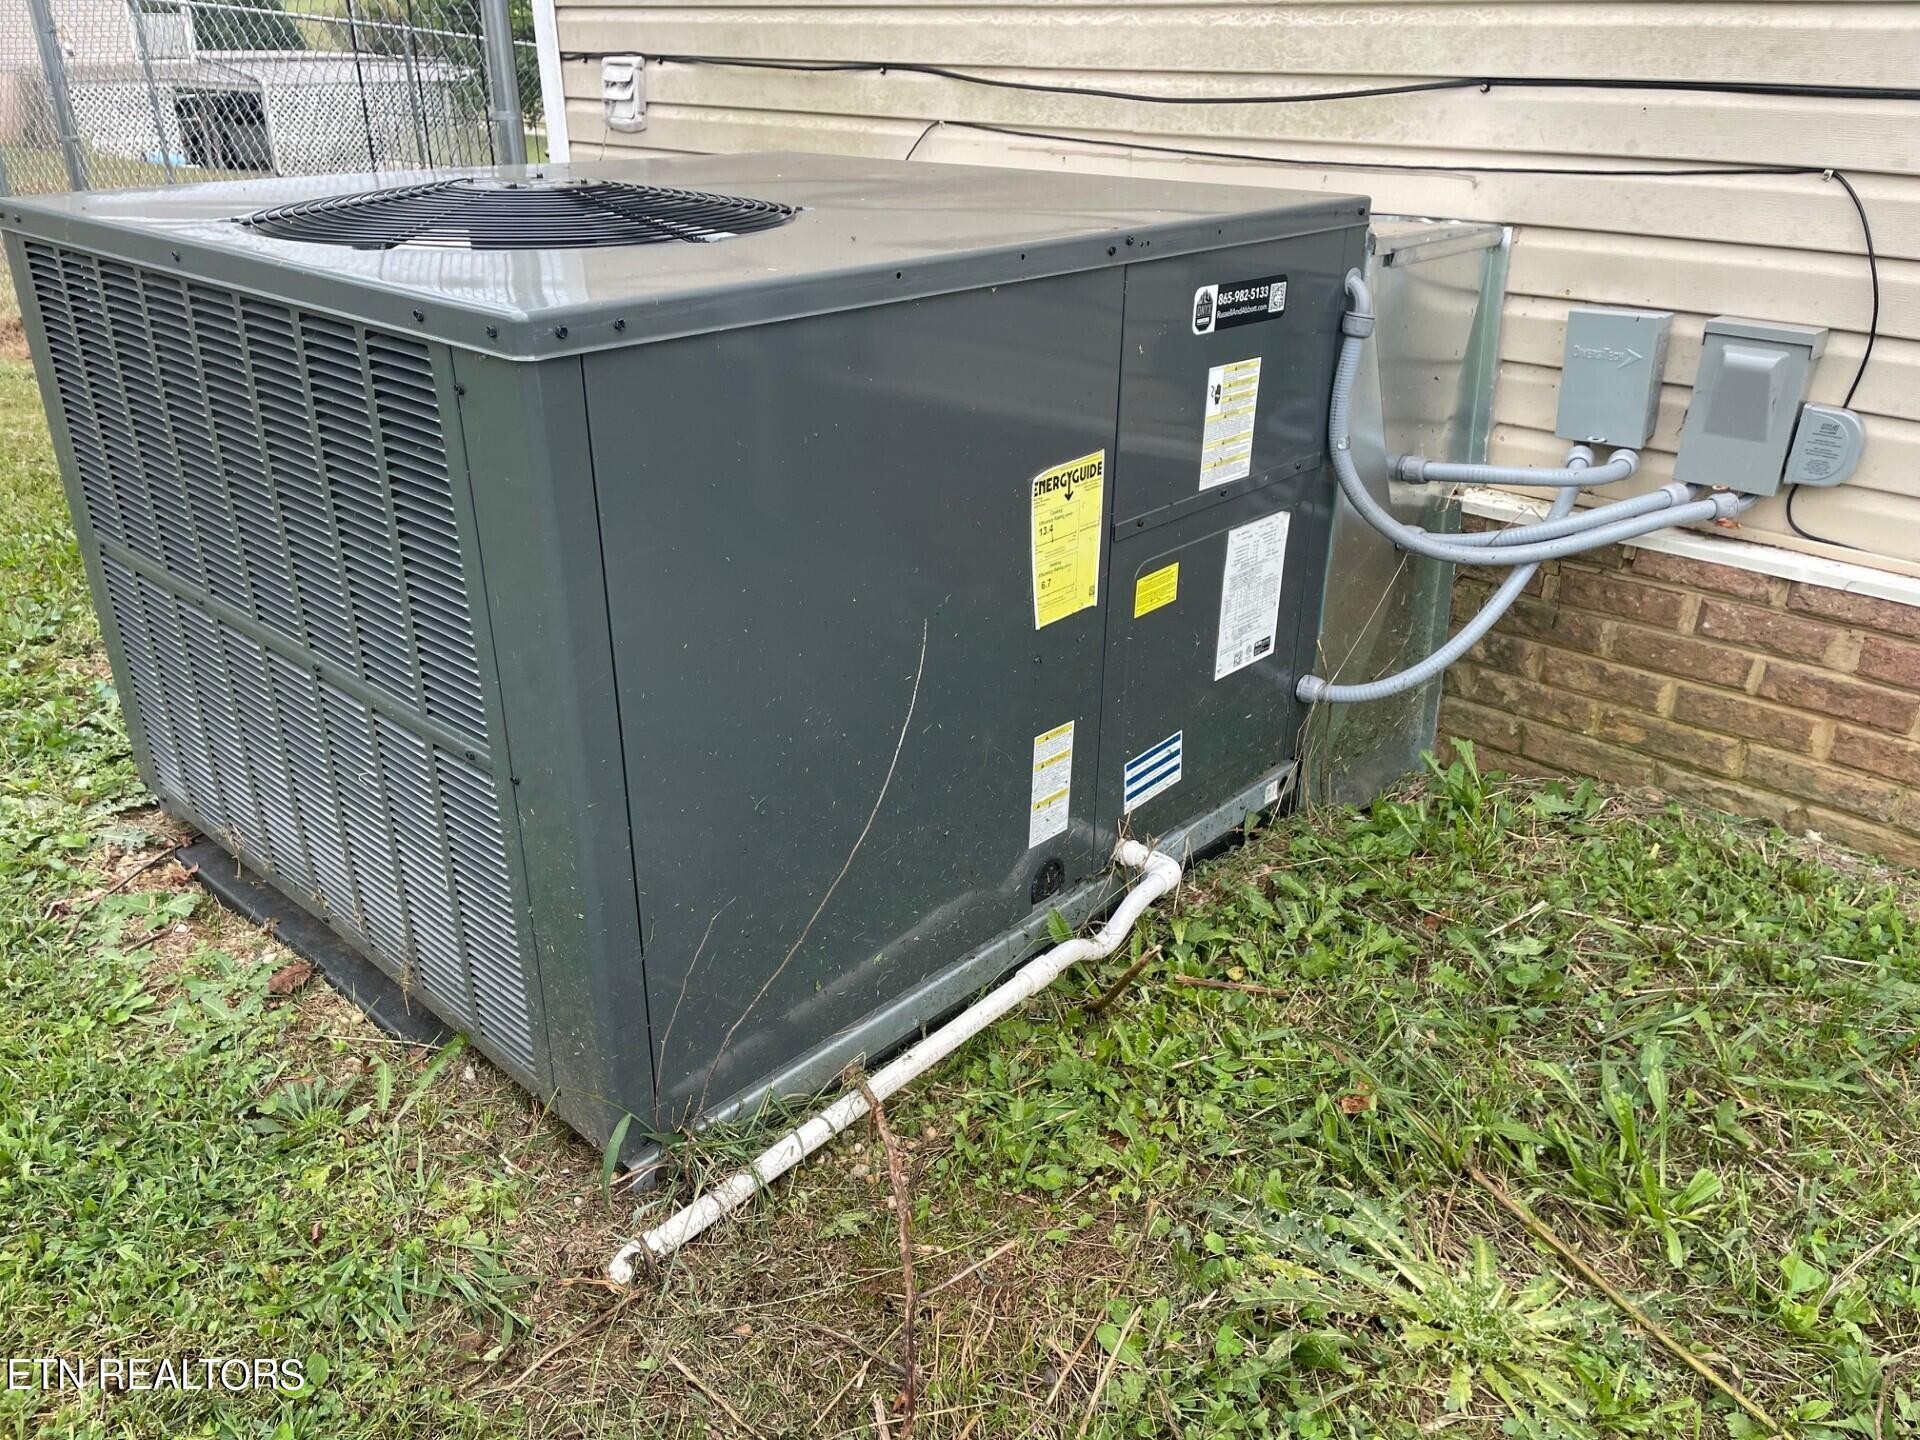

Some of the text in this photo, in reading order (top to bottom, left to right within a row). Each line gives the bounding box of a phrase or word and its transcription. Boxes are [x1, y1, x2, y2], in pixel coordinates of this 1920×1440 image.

[1218, 285, 1269, 305] 865-982-5133
[1039, 524, 1054, 537] 13.4
[1041, 578, 1052, 590] 6.7
